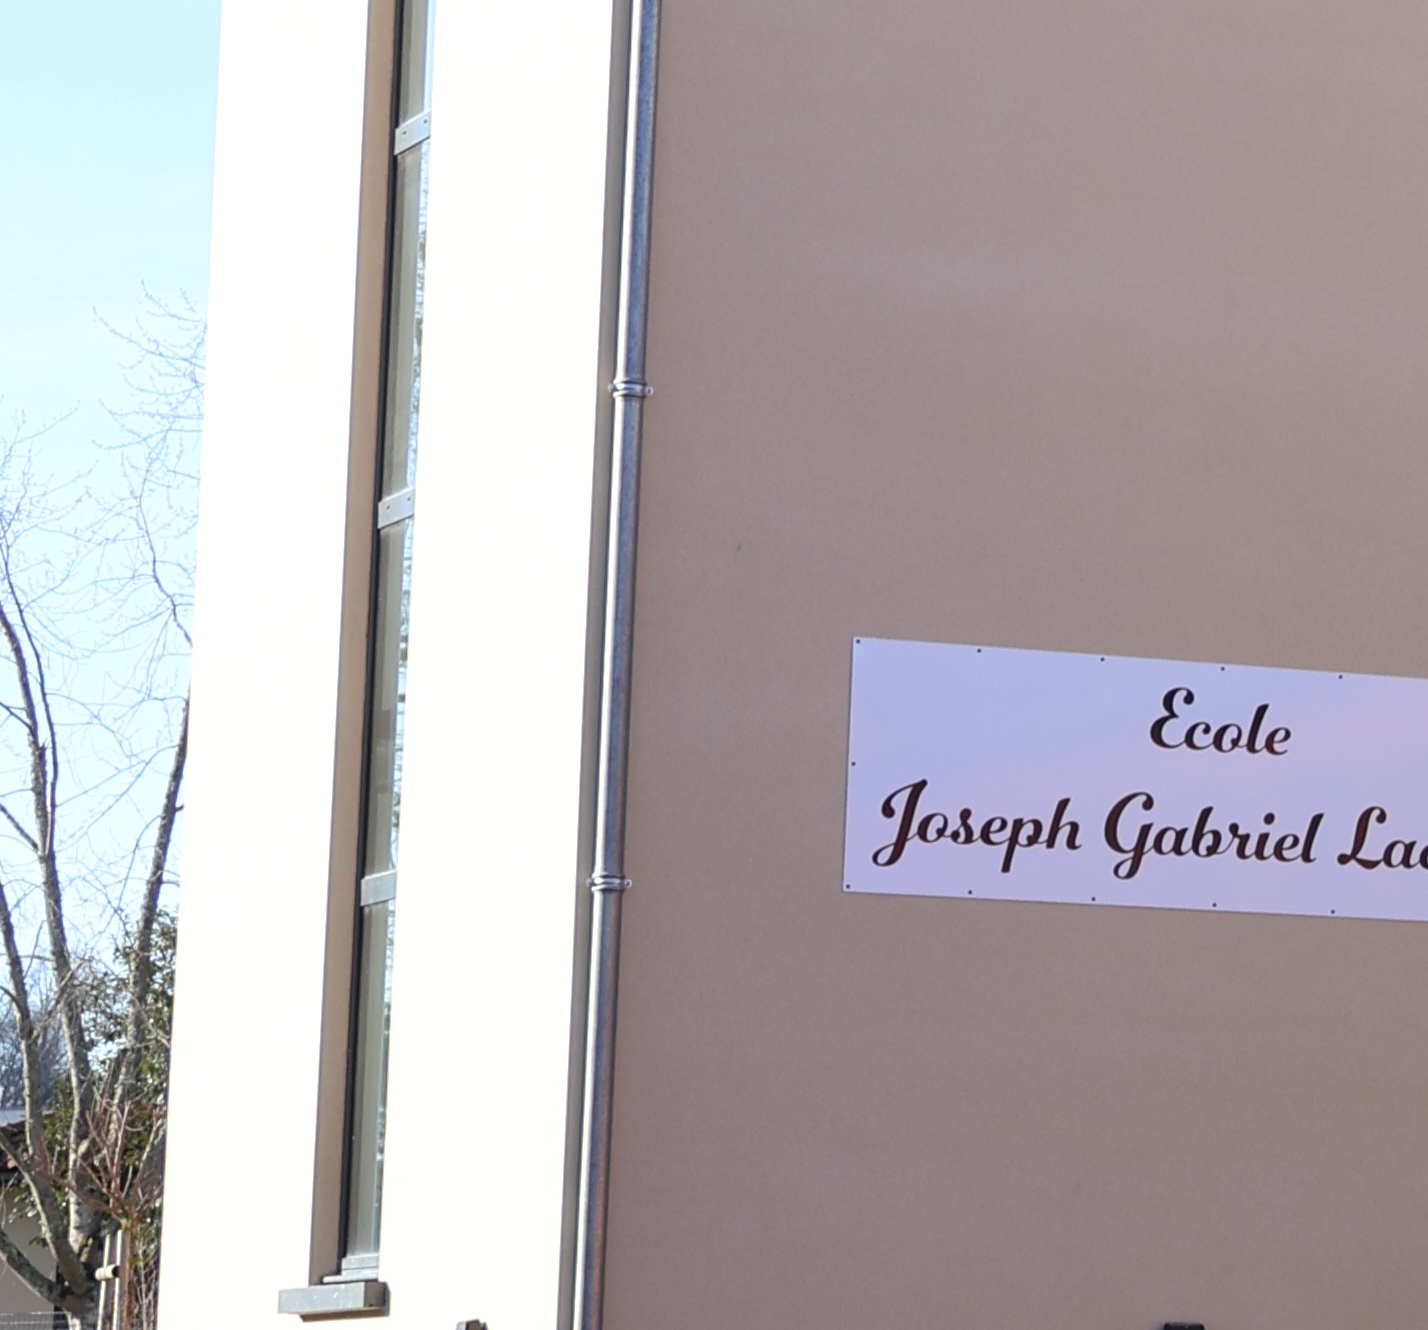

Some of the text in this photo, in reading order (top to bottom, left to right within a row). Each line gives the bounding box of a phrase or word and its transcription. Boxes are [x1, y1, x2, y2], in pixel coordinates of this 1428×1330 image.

[1149, 687, 1292, 756] Ecole
[871, 778, 1083, 874] Joseph
[1104, 791, 1325, 880] Gabriel
